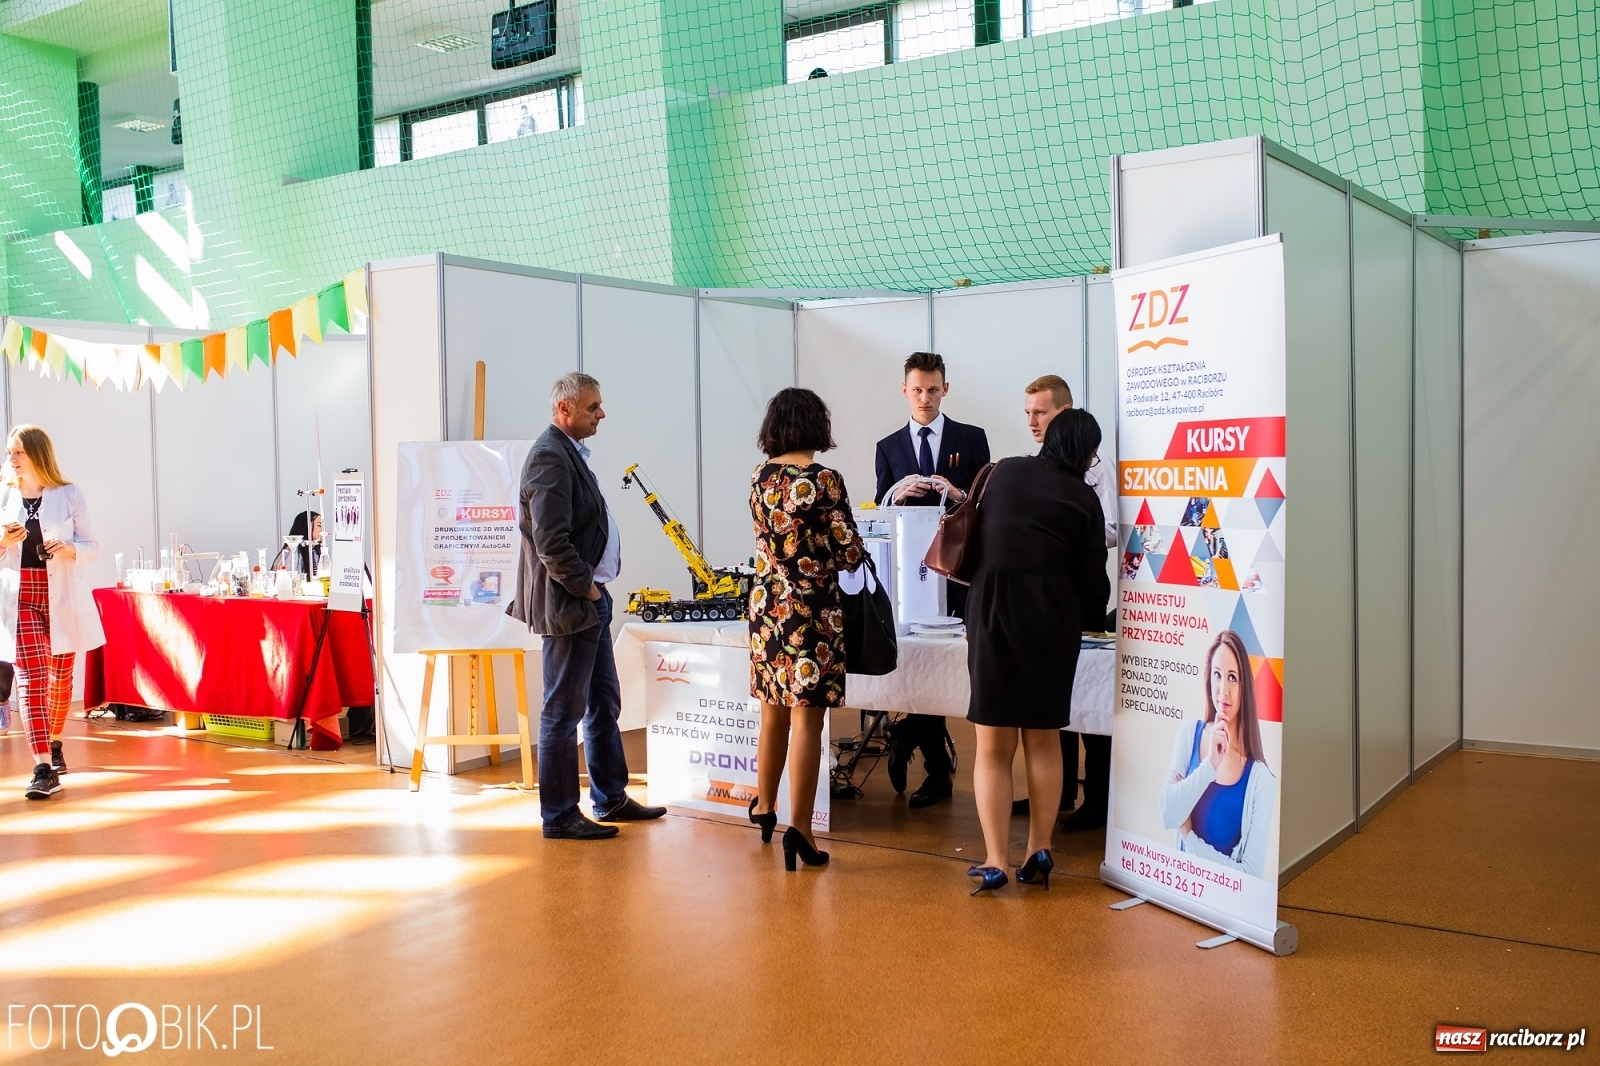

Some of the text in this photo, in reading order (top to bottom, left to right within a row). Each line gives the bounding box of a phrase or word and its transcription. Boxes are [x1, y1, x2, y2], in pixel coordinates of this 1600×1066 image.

[1129, 284, 1190, 331] ZDZ
[1126, 361, 1206, 378] OŚRODEK KSZTAŁCENIA
[1126, 378, 1180, 391] ZAWODOWEGO
[1188, 372, 1227, 386] RACIBORZU
[1133, 392, 1159, 404] Podwale
[1172, 389, 1196, 400] 47-400
[1197, 388, 1224, 398] Racibórz
[1126, 403, 1204, 418] raciborz@zdz.katowice.pl
[1186, 426, 1250, 453] KURSY
[1124, 466, 1228, 491] SZKOLENIA
[462, 508, 510, 519] KURSY
[1122, 591, 1186, 608] ZAINWESTUJ
[1122, 609, 1209, 633] Z NAMI W SWOJĄ
[1122, 626, 1184, 646] PRZYSZŁOŚĆ
[657, 654, 690, 674] ZDZ
[1122, 654, 1199, 676] WYBIERZ SPOŚRÓD
[1121, 669, 1167, 686] PONAD 200
[1121, 683, 1168, 701] ZAWODÓW
[700, 698, 760, 714] OPERATO
[1125, 699, 1183, 720] SPECJALNOŚCI
[676, 712, 760, 730] BEZZAŁOGO
[652, 724, 758, 747] STATKÓW POWIE
[689, 750, 758, 773] DRONÓ
[1121, 840, 1242, 892] www.kursy.raciborz.zdz.pl
[1121, 855, 1204, 898] tel. 32 415 26 17
